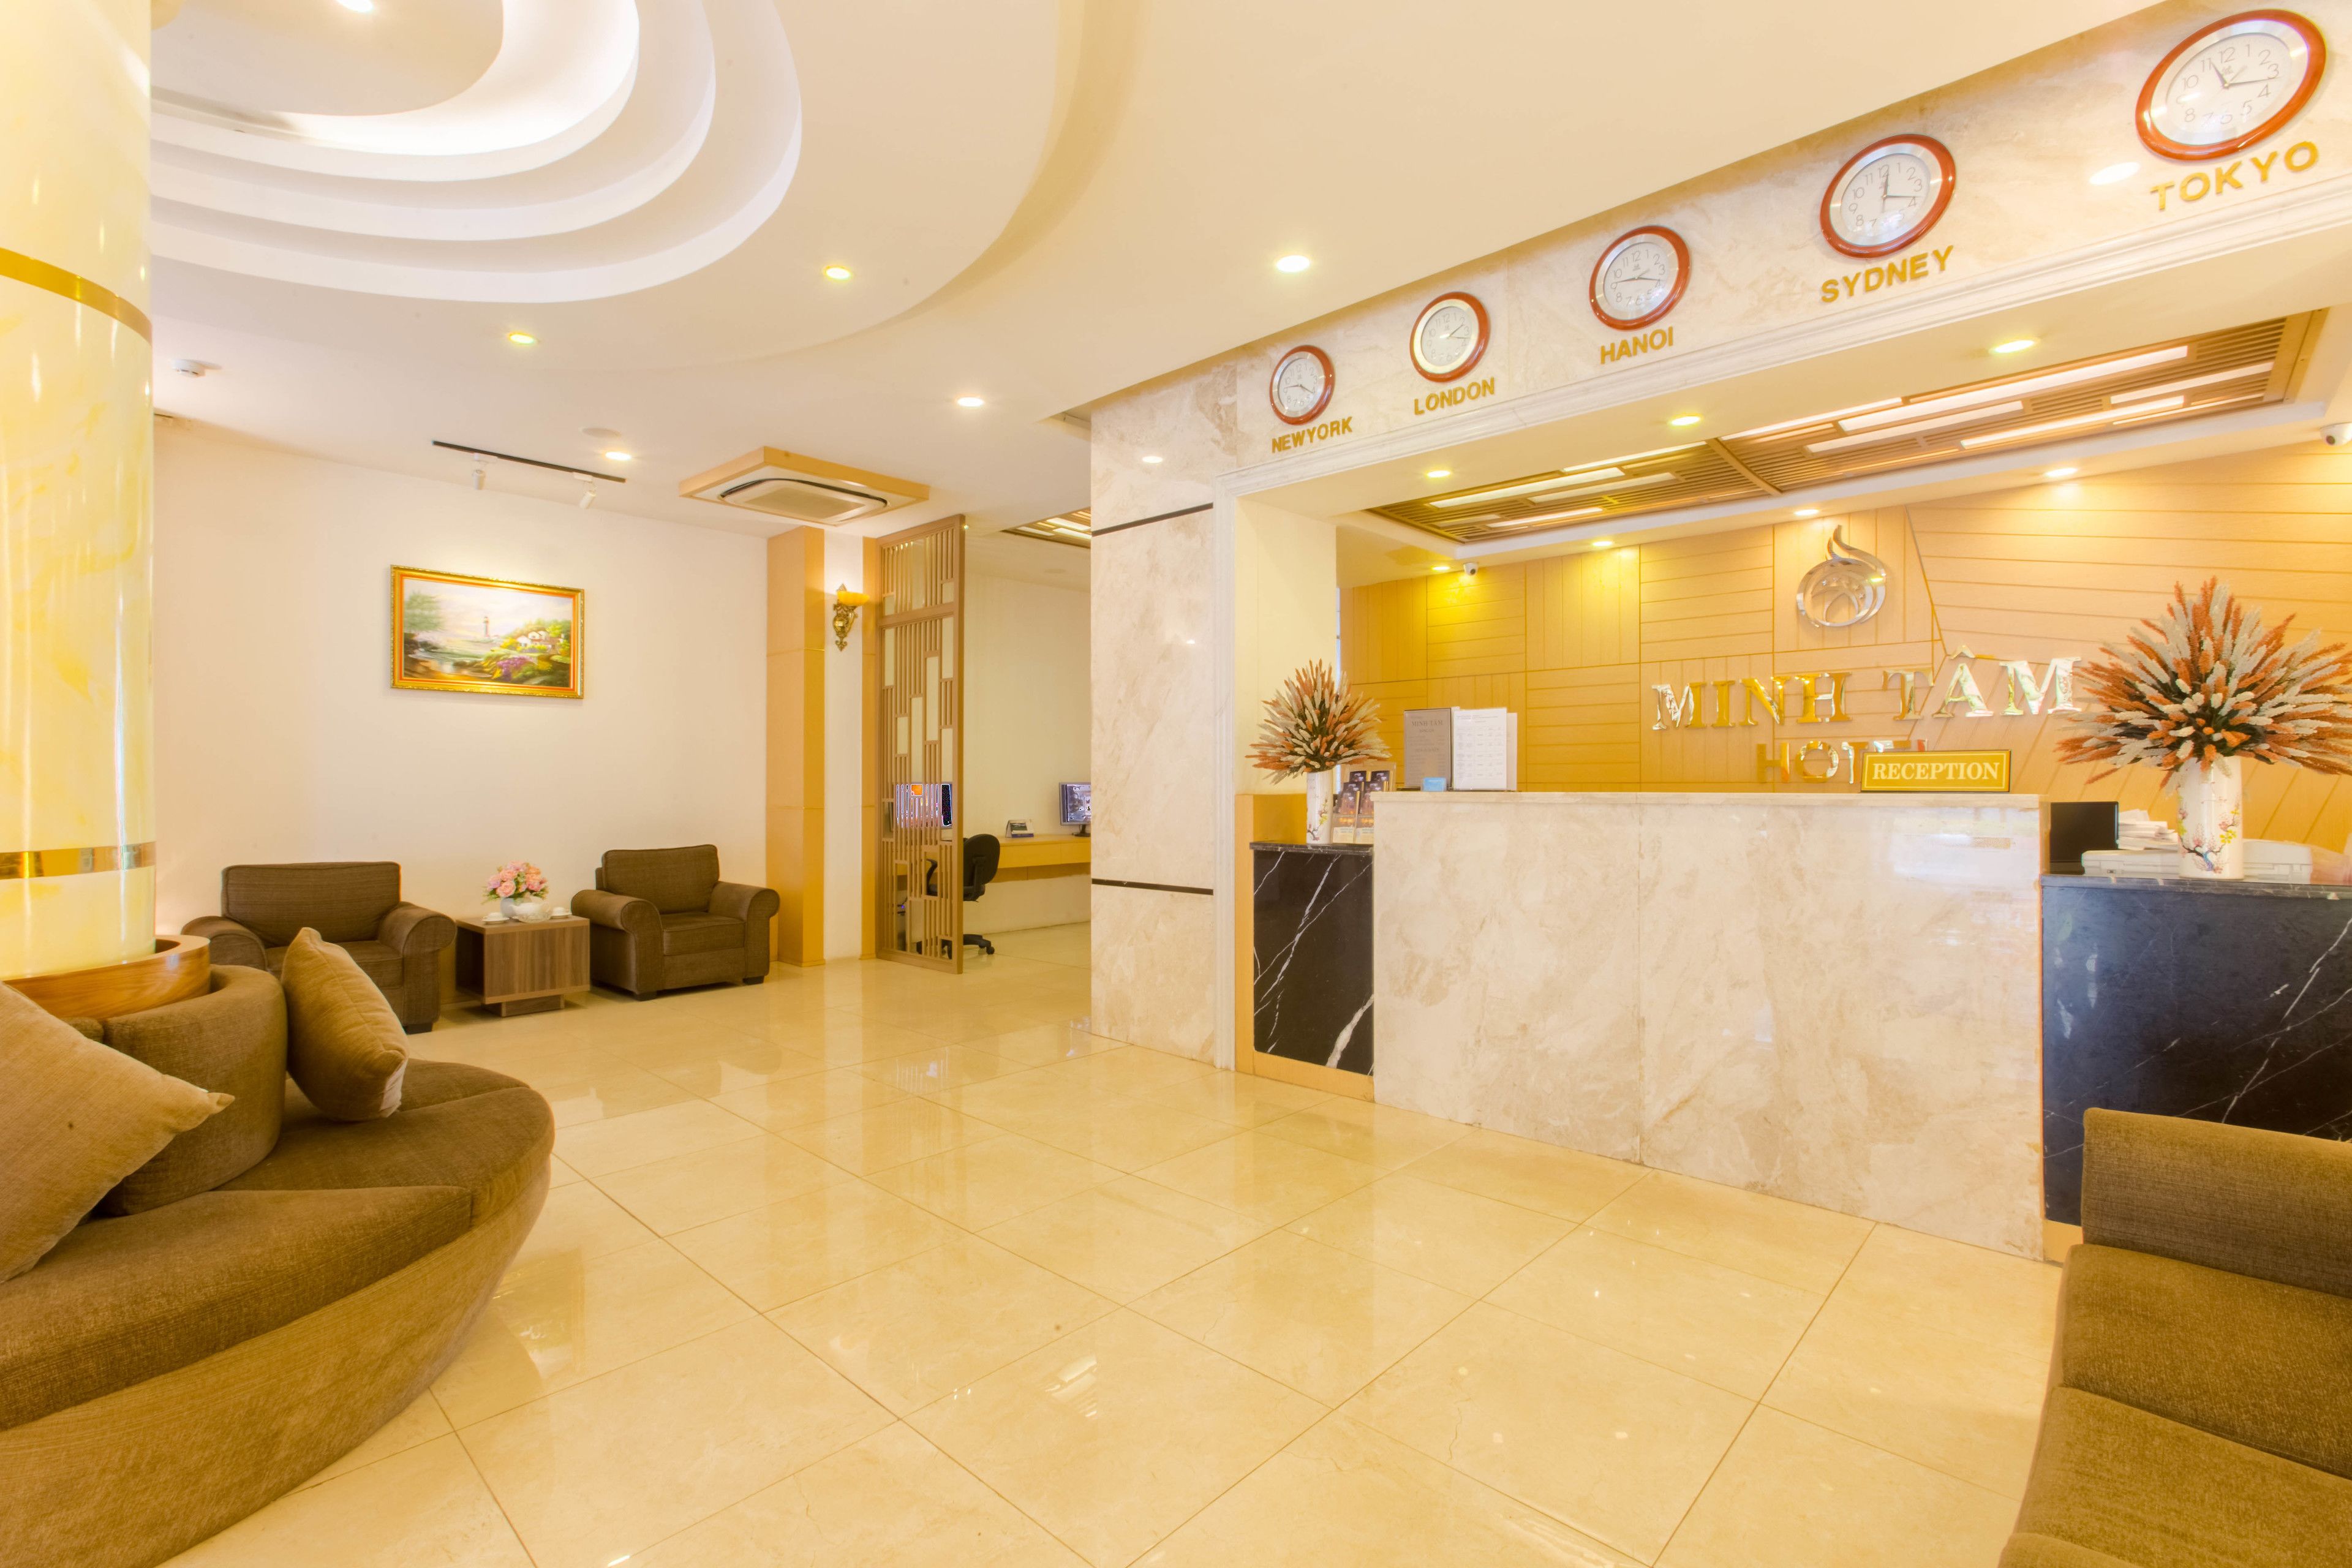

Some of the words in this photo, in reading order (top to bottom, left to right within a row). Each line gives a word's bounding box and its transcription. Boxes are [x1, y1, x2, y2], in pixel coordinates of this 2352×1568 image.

[2218, 47, 2236, 64] 12
[2245, 44, 2250, 57] 1
[2258, 49, 2271, 66] 2
[2201, 58, 2211, 73] 11
[2267, 63, 2279, 80] 3
[2182, 75, 2199, 91] 10
[2257, 84, 2271, 98] 4
[2240, 100, 2252, 116] 5
[2185, 108, 2196, 123] 8
[1896, 162, 1901, 173] 1
[1906, 167, 1916, 181] 2
[1863, 172, 1873, 186] 11
[2150, 141, 2319, 211] TOKYO
[1913, 178, 1923, 192] 3
[1852, 187, 1864, 200] 10
[1908, 196, 1917, 207] 4
[1849, 203, 1858, 214] 9
[1856, 214, 1864, 227] 8
[1622, 257, 1629, 268] 11
[1631, 250, 1642, 262] 12
[1653, 254, 1660, 265] 2
[1614, 268, 1623, 279] 10
[1659, 264, 1665, 275] 3
[1821, 245, 1954, 303] SYDNEY
[1610, 282, 1617, 292] 9
[1616, 292, 1623, 303] 8
[1626, 296, 1632, 307] 7
[1635, 295, 1642, 306] 6
[1435, 318, 1441, 329] 11
[1442, 313, 1450, 323] 12
[1428, 328, 1436, 337] 10
[1464, 326, 1470, 336] 3
[1600, 326, 1673, 364] HANOI
[1414, 377, 1495, 415] LONDON
[1272, 416, 1353, 453] NEWYORK
[1651, 672, 1852, 731] MINH
[1882, 644, 2082, 721] TÂM
[1757, 739, 1928, 785] HOT
[1872, 762, 2000, 780] RECEPTION
